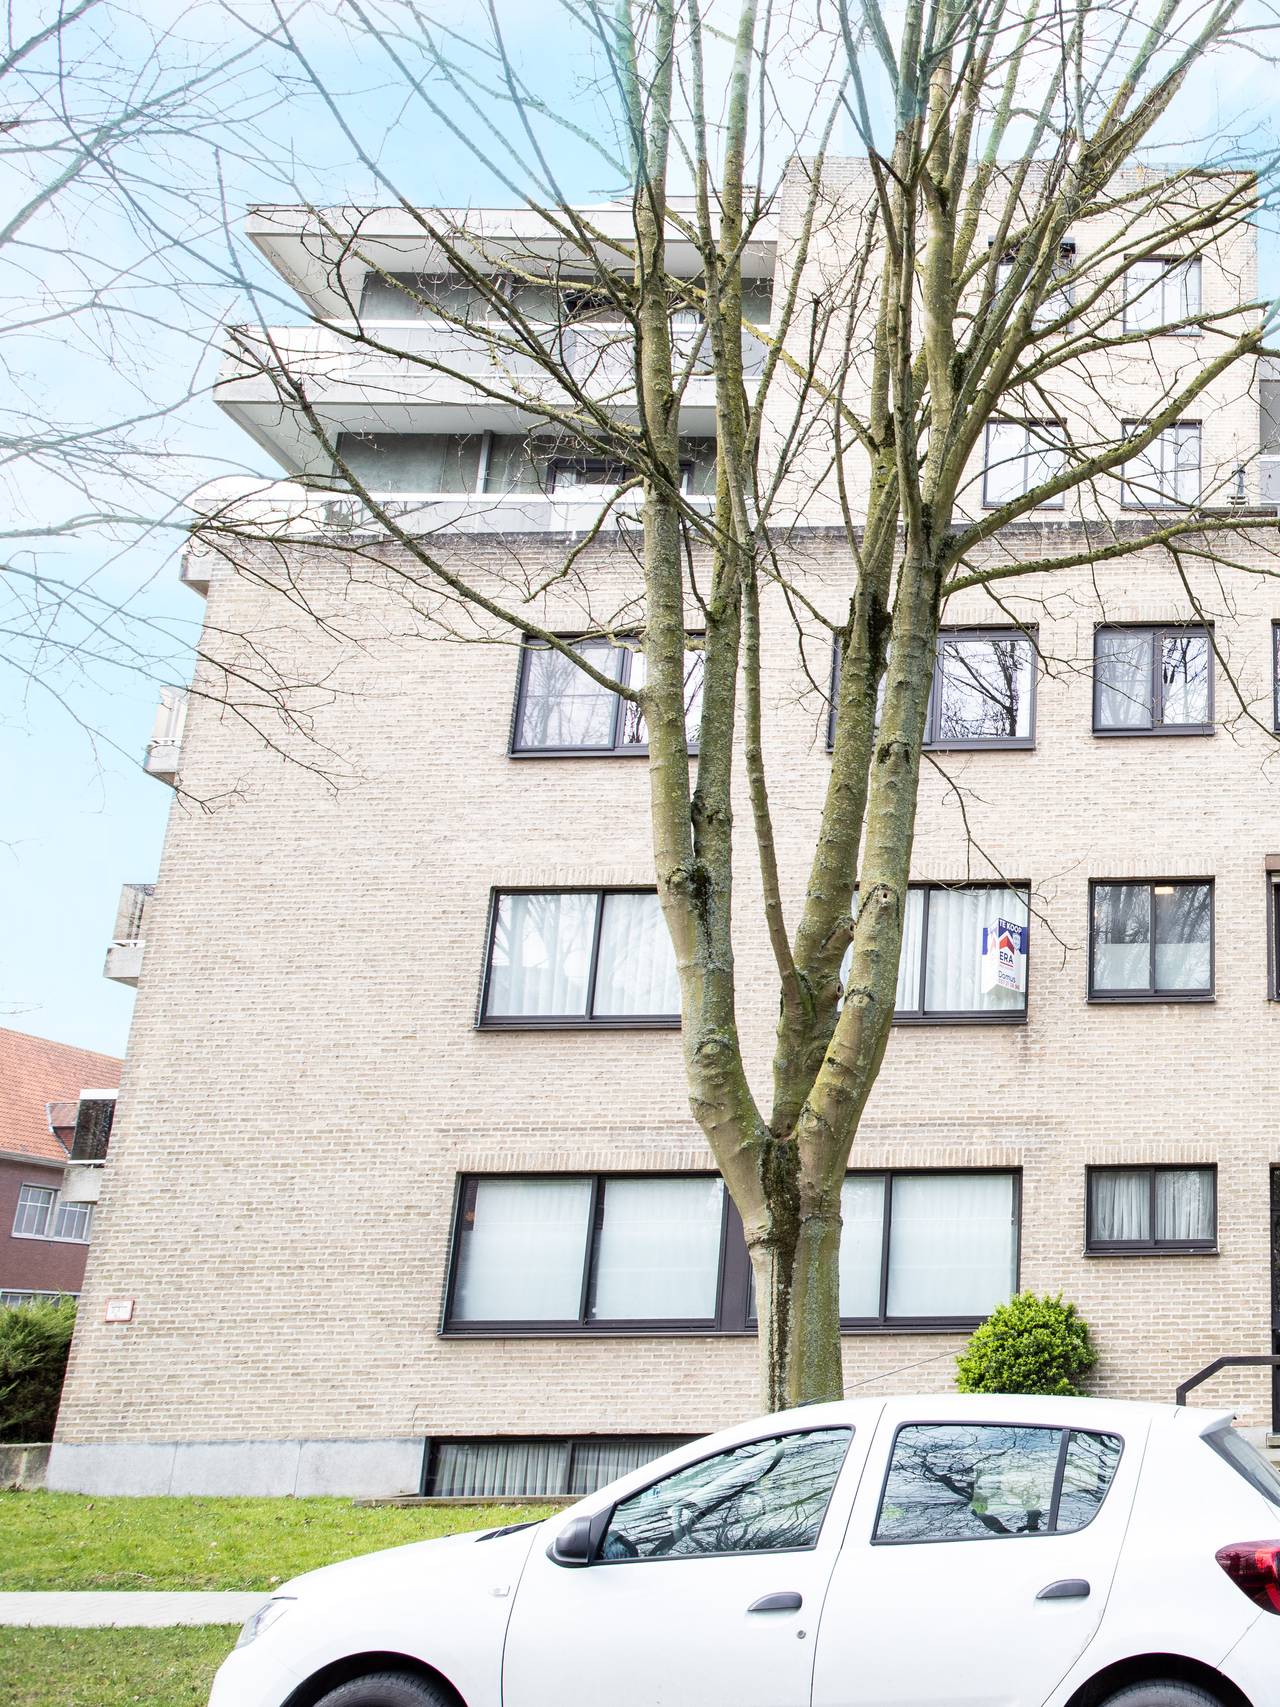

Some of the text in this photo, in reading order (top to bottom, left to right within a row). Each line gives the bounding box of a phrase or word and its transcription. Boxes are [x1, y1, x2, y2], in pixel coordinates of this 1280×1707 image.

[999, 920, 1022, 933] TE KOOP
[1000, 951, 1014, 964] ERA
[999, 970, 1016, 983] Domus
